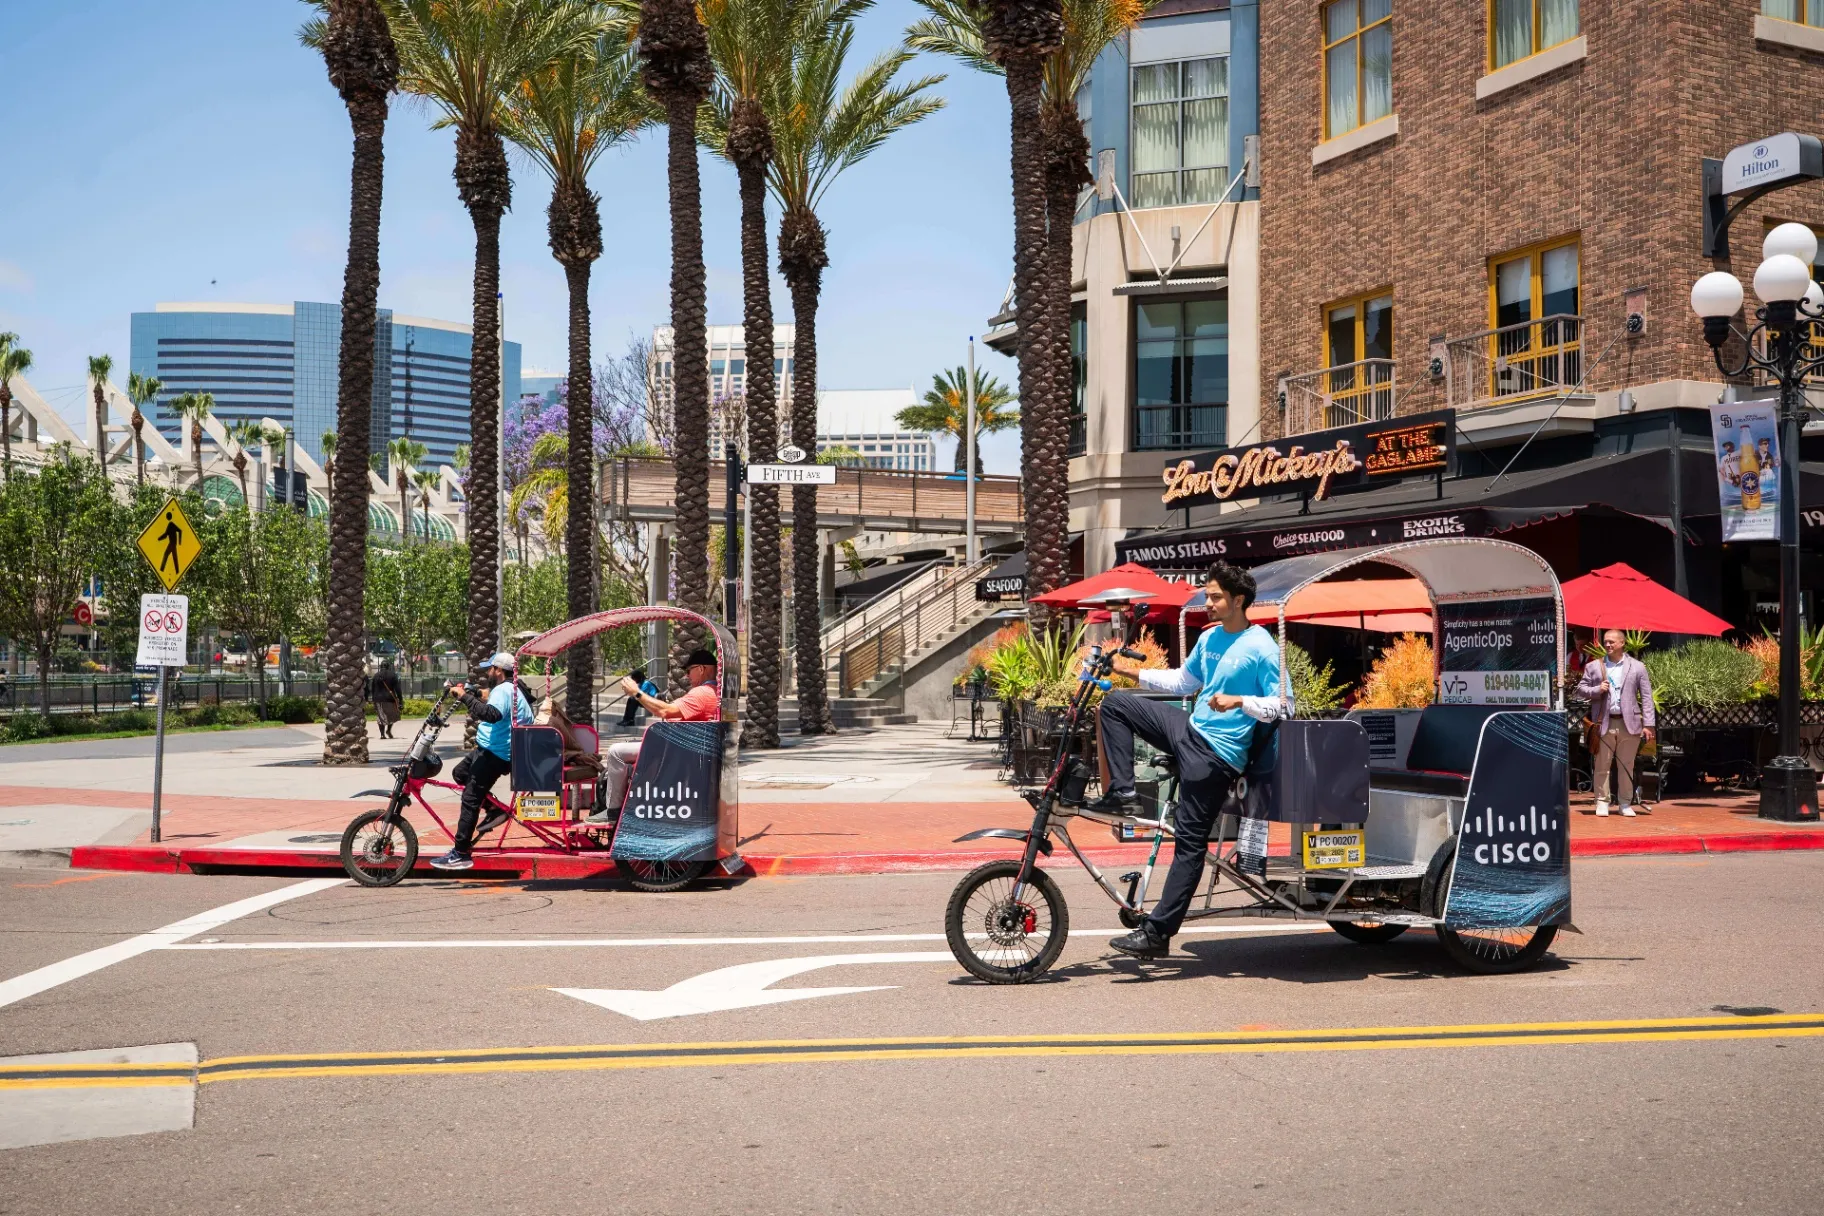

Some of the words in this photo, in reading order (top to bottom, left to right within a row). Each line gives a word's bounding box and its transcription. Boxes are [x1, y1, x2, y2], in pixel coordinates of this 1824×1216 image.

[1742, 159, 1779, 177] Hilton
[1377, 436, 1395, 451] AT
[1399, 430, 1429, 448] THE
[1366, 446, 1440, 469] GASLAMP
[763, 468, 803, 481] FIFTH
[1162, 460, 1213, 503] Lou
[1211, 440, 1362, 501] Mickey's
[1403, 516, 1460, 530] EXOTIC
[1403, 524, 1466, 538] DRINKS
[1125, 545, 1177, 562] FAMOUS
[1177, 540, 1227, 558] STEAKS
[1273, 533, 1298, 548] Choice
[1298, 529, 1345, 544] SEAFOOD
[986, 578, 1022, 592] SEAFOOD
[78, 609, 89, 621] C
[1444, 620, 1469, 629] Simplicity
[1444, 630, 1513, 652] AgenticOps
[1530, 634, 1555, 645] CISCO
[1444, 675, 1468, 696] VIP
[1444, 696, 1472, 704] PEDICAB
[1505, 696, 1519, 704] BOOK
[1520, 696, 1533, 704] YOUR
[1534, 696, 1547, 704] RIDE
[635, 804, 692, 819] CISCO
[1320, 836, 1331, 846] PC
[1332, 835, 1357, 846] 00207
[1474, 841, 1551, 864] CISCO
